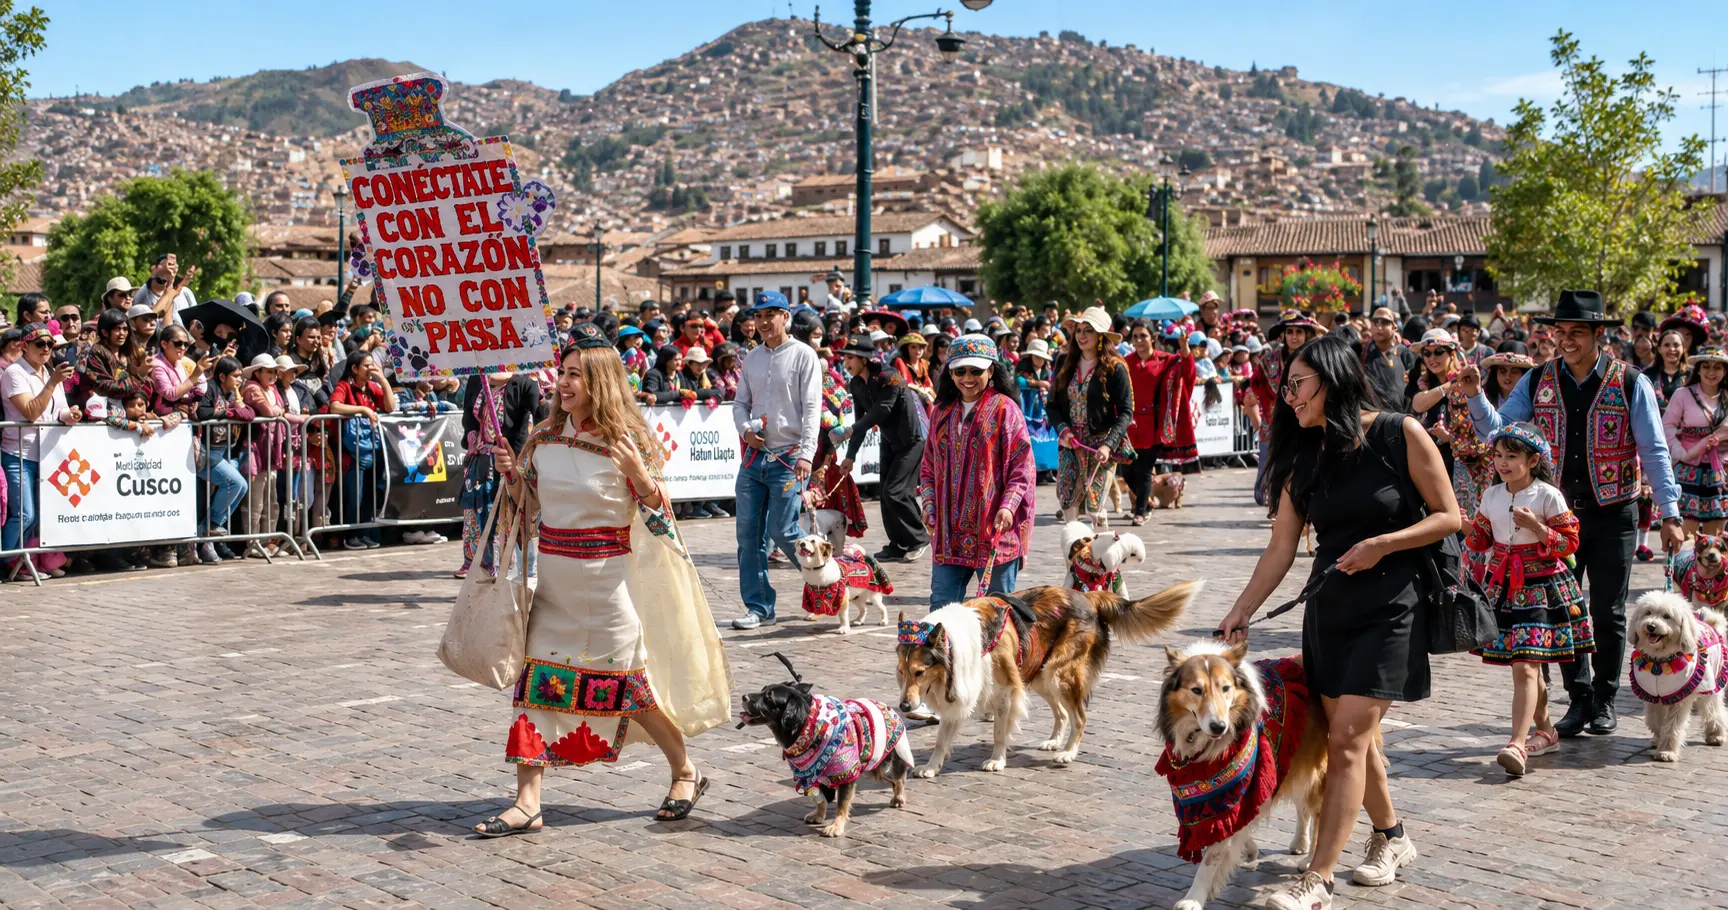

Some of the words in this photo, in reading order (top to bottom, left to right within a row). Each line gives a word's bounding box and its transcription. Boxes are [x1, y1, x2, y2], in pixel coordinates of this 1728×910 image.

[351, 159, 513, 209] CONÉCTATE
[376, 207, 445, 243] CON
[455, 201, 505, 236] EL
[398, 285, 446, 318] NO
[458, 277, 531, 312] CON
[690, 430, 720, 446] QOSQO
[690, 447, 713, 462] Hatun
[116, 473, 182, 497] Cusco
